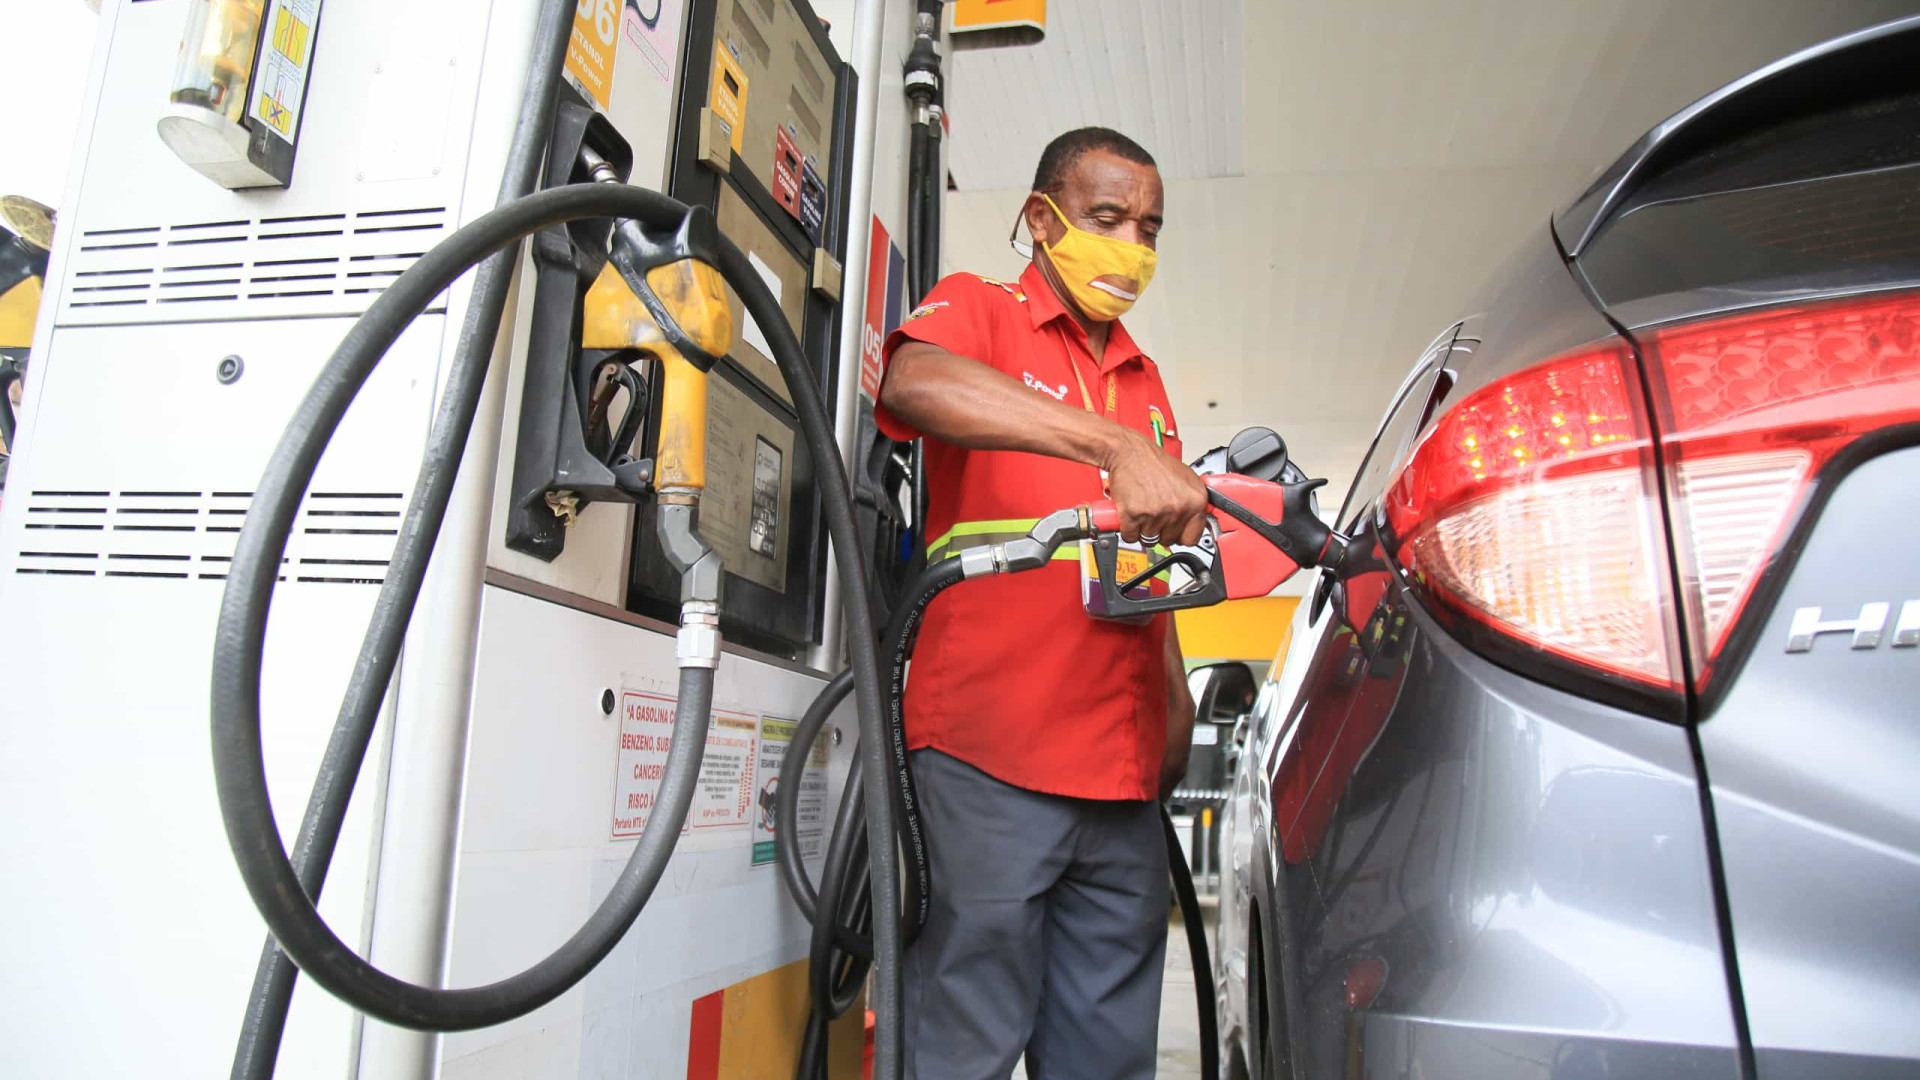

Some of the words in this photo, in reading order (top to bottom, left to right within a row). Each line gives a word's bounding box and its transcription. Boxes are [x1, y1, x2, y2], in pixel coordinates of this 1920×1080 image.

[573, 27, 605, 71] ETANOL
[865, 323, 881, 364] 05
[635, 705, 669, 724] GASOLINA
[621, 733, 655, 755] BENZENO,
[628, 793, 649, 810] RISCO
[900, 767, 913, 811] PORTARIA
